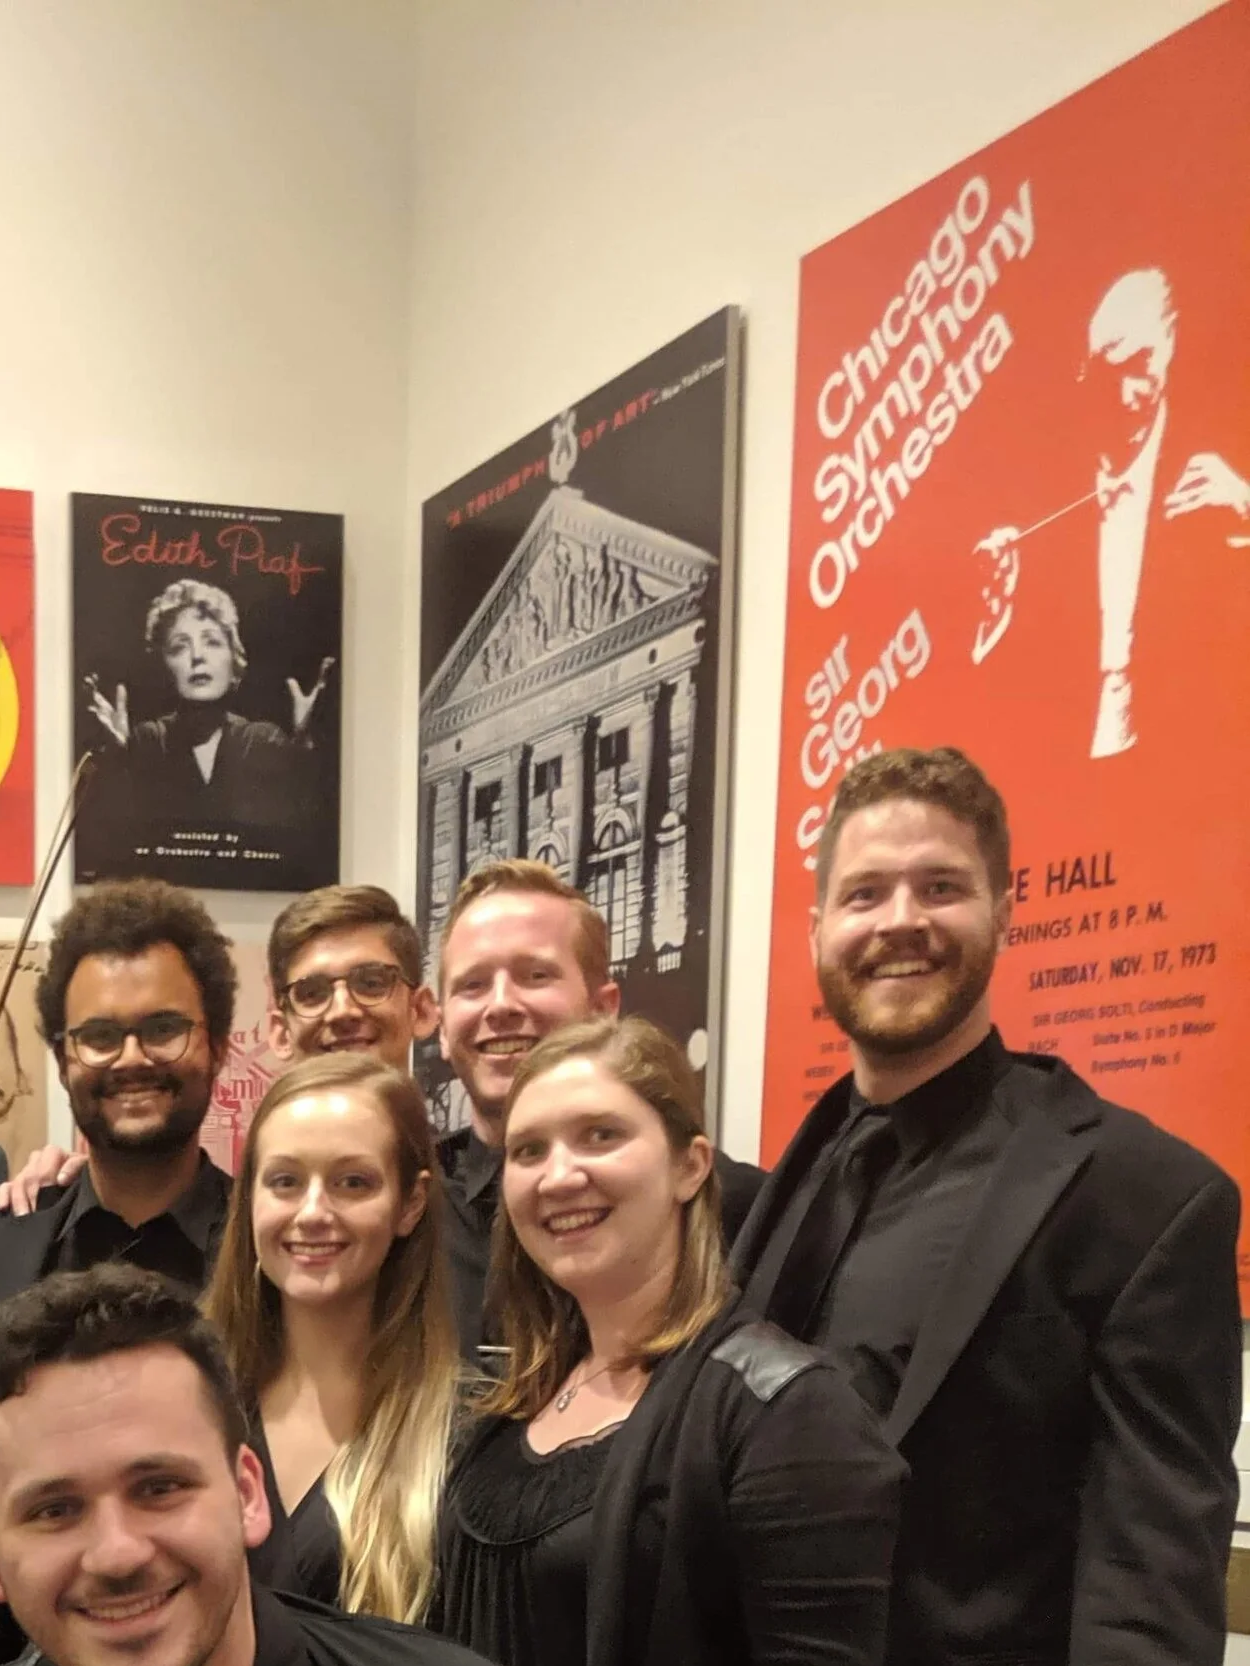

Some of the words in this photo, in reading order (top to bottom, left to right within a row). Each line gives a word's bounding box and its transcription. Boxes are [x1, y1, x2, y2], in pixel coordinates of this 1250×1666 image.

[813, 177, 1035, 523] Symphony
[817, 175, 990, 440] Chicago
[809, 312, 1014, 609] Orchestra
[102, 513, 217, 568] Edith
[217, 524, 325, 596] Piaf
[801, 608, 931, 789] Georg
[1007, 917, 1072, 947] ENINGS
[1078, 911, 1102, 937] AT
[1109, 908, 1119, 931] 8
[1045, 851, 1117, 898] HALL
[1029, 963, 1103, 993] SATURDAY,
[1110, 955, 1146, 979] NOV.
[1181, 942, 1217, 969] 1973
